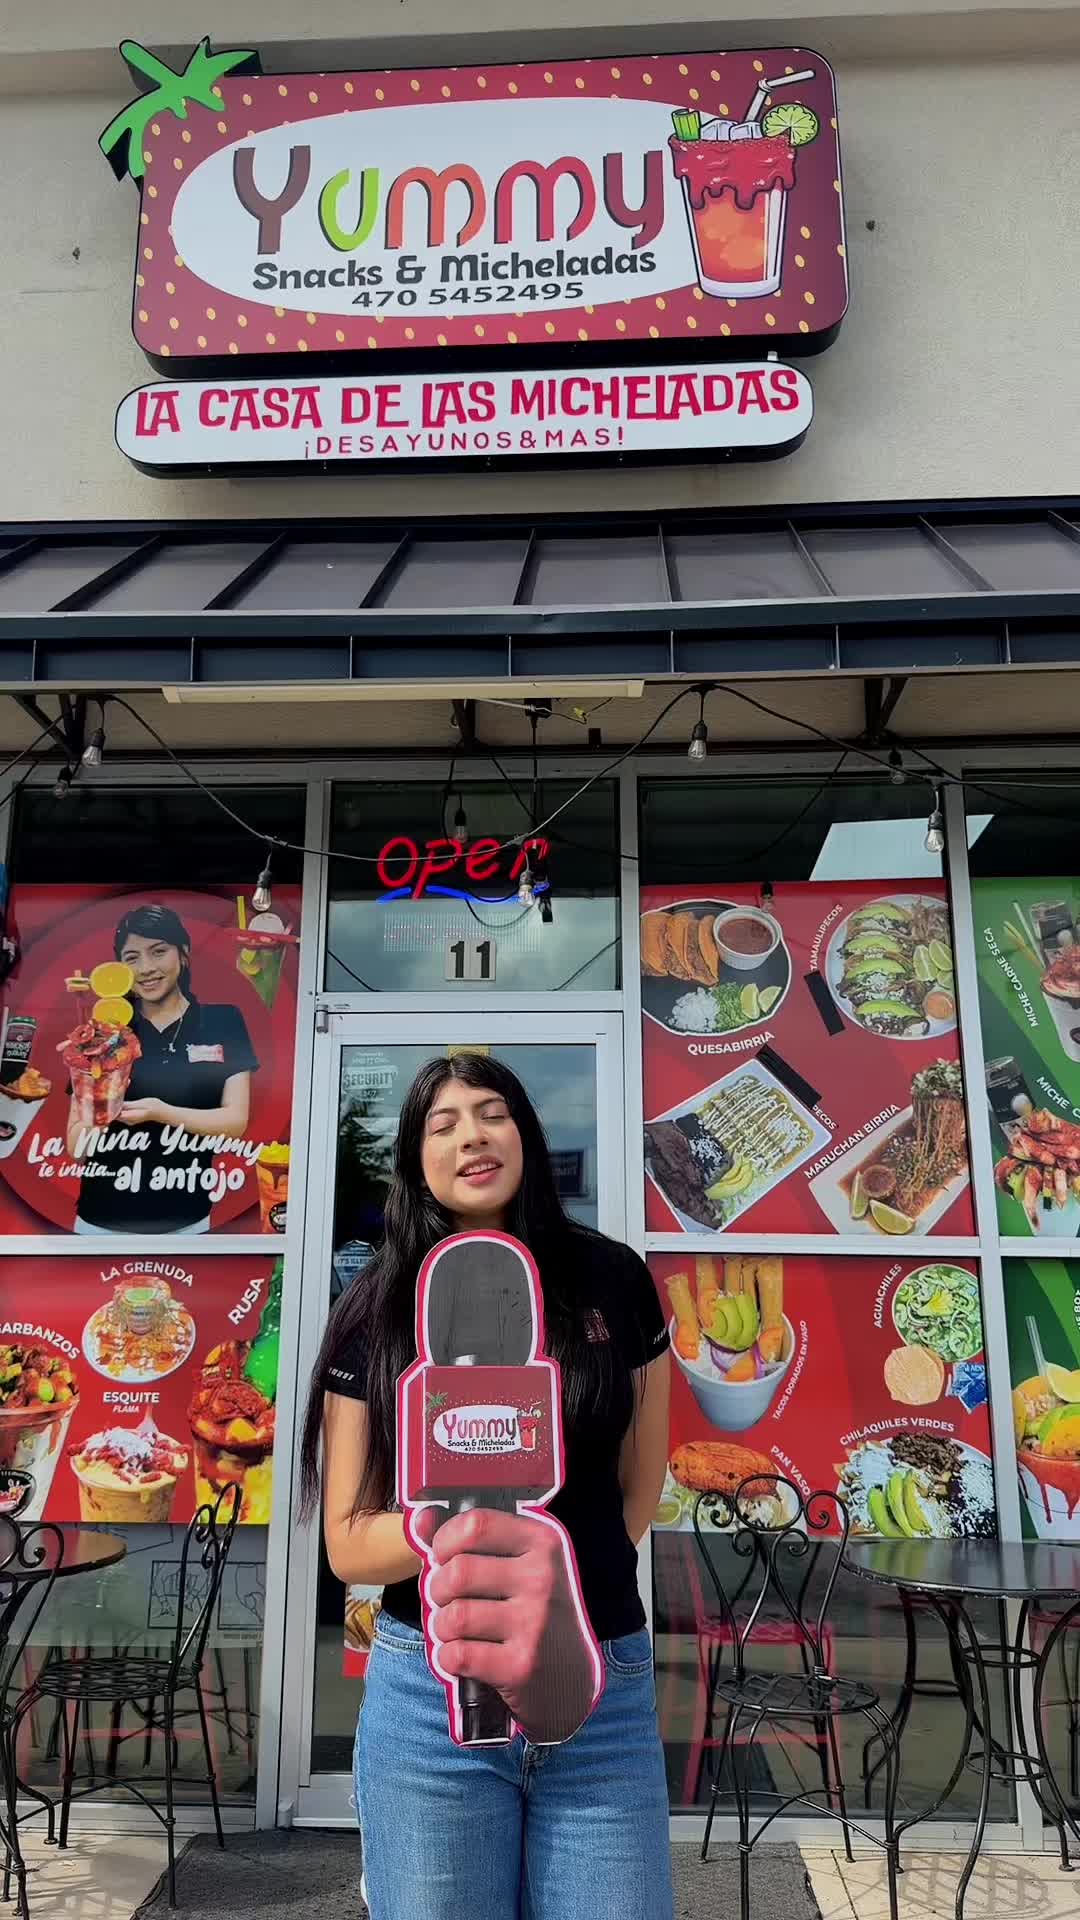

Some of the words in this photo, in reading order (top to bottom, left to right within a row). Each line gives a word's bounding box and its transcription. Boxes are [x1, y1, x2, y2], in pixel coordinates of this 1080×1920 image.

[233, 145, 664, 255] Yummy
[252, 259, 383, 290] Snacks
[395, 255, 427, 285] &
[439, 246, 657, 284] Micheladas
[351, 289, 418, 308] 470
[428, 282, 585, 306] 5452495
[135, 390, 181, 437] LA
[198, 386, 323, 431] CASA
[340, 384, 409, 428] DE
[421, 380, 497, 429] LAS
[510, 369, 800, 422] MICHELADAS
[809, 904, 844, 971] TAMAULIPECOS
[983, 927, 1001, 956] SECA
[449, 940, 491, 979] 11
[996, 956, 1023, 991] CARNE
[1018, 991, 1039, 1028] MICHE
[687, 1031, 775, 1056] QUESABIRRIA
[1036, 1076, 1070, 1110] MICHE
[27, 1132, 65, 1164] La
[160, 1123, 264, 1166] Yummy
[803, 1129, 865, 1179] MARUCHAN
[863, 1104, 901, 1134] BIRRIA
[38, 1162, 54, 1178] te
[113, 1157, 142, 1193] al
[149, 1157, 245, 1203] antojo
[100, 1266, 120, 1282] LA
[123, 1261, 194, 1287] GRENUDA
[227, 1277, 265, 1326] RUSA
[873, 1263, 903, 1329] AGUACHILES
[0, 1322, 80, 1360] ARBANZOS
[103, 1391, 160, 1405] ESQUITE
[772, 1394, 789, 1420] TACOS
[785, 1355, 805, 1395] DORADOS
[442, 1413, 516, 1440] Yummy
[839, 1417, 908, 1446] CHILAQUILES
[911, 1417, 955, 1432] VERDES
[770, 1445, 791, 1466] PAN
[790, 1462, 811, 1497] VASO
